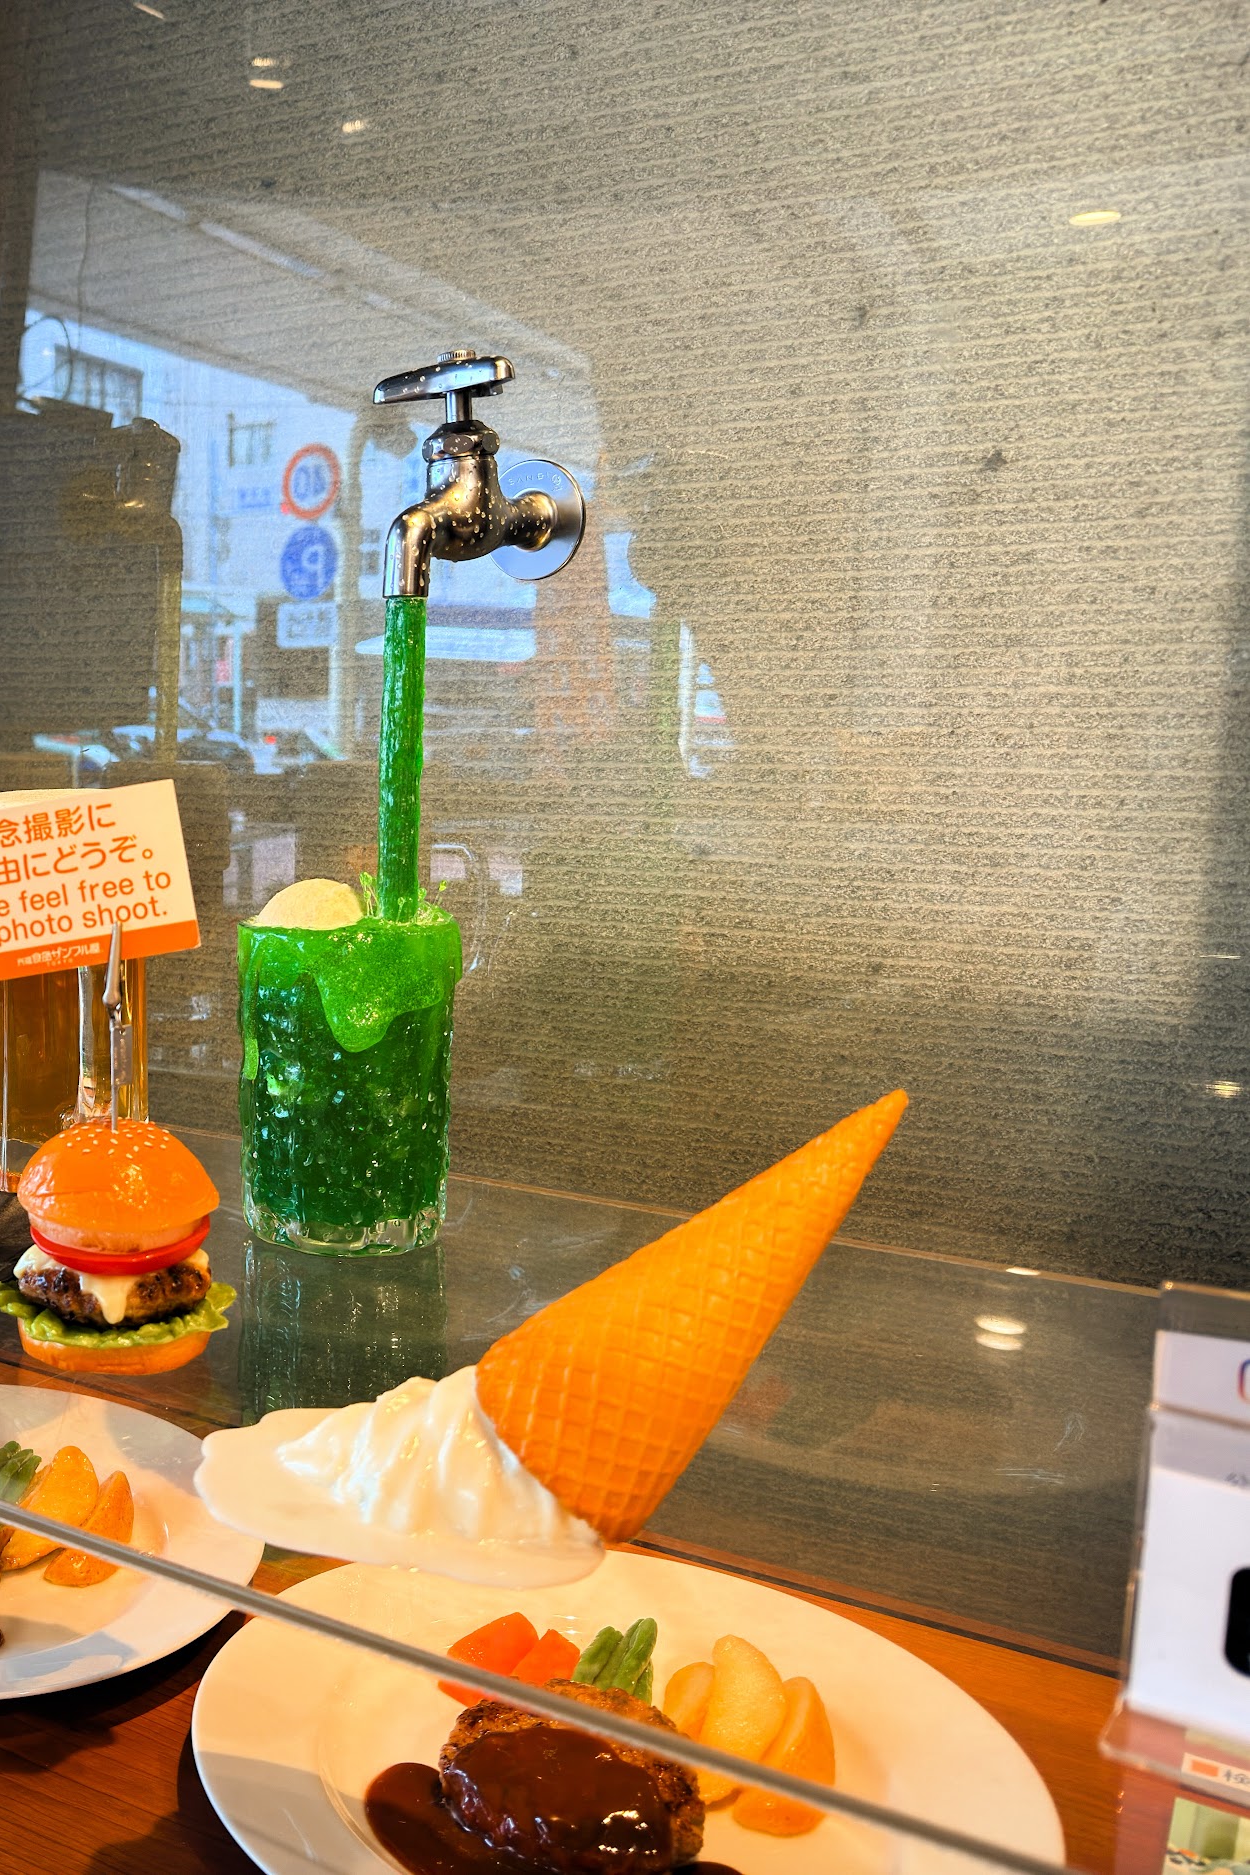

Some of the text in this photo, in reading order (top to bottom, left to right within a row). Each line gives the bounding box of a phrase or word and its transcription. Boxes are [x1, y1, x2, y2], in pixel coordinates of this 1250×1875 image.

[19, 884, 69, 913] feel
[79, 876, 134, 903] free
[144, 869, 171, 890] to
[83, 895, 168, 930] shoot.
